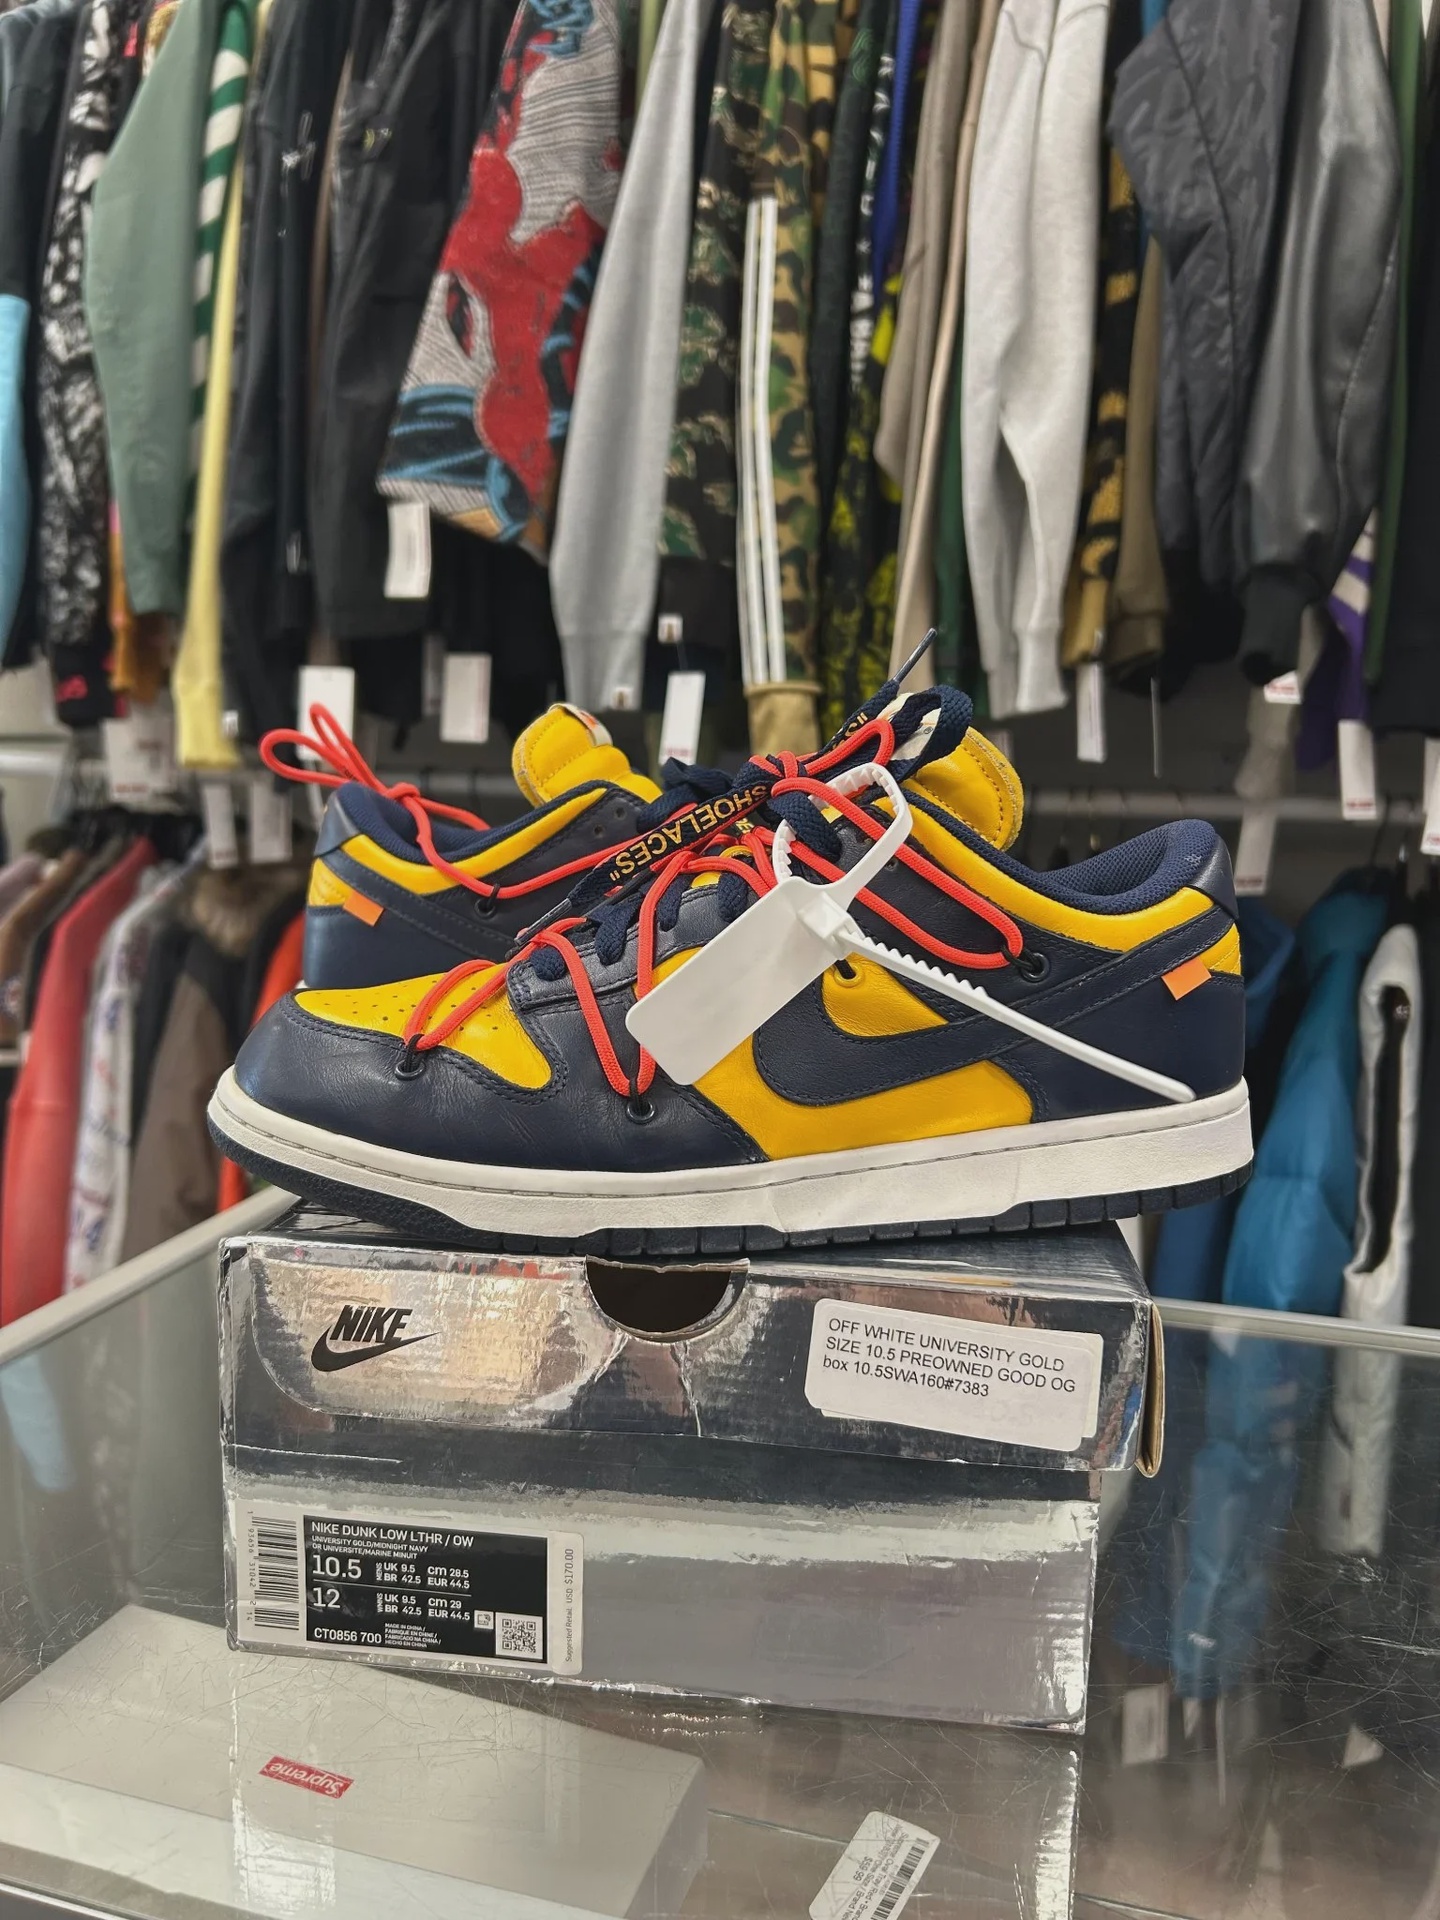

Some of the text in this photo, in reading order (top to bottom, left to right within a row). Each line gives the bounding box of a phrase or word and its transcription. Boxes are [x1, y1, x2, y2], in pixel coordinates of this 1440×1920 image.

[330, 1304, 413, 1343] NIKE
[828, 1317, 1065, 1372] OFF WHITE UNIVERSITY GOLD
[823, 1354, 989, 1397] box 10.5SWA160#7383
[825, 1337, 1076, 1393] SIZE 10.5 PREOWNED GOOD OG
[311, 1521, 339, 1534] NIKE
[342, 1524, 377, 1538] DUNK
[380, 1528, 408, 1541] LOW
[410, 1531, 443, 1545] LTHR
[453, 1535, 474, 1547] OW
[312, 1535, 428, 1553] UNIVERSITY GOLD/MIDNIGHT NAVY
[312, 1554, 362, 1579] 10.5
[393, 1551, 417, 1560] MINUIT
[564, 1548, 574, 1585] $170.00
[384, 1562, 469, 1578] UK 9.5 cm 28.5
[384, 1573, 470, 1589] BR 42.5 EUR 44.5
[312, 1587, 341, 1609] 12
[384, 1593, 462, 1609] UK 9.5 cm 29
[565, 1588, 573, 1603] USD
[384, 1604, 470, 1621] BR 42.5 EUR 44.5
[314, 1627, 382, 1644] CT0856 700
[564, 1628, 574, 1663] Suggested
[269, 1762, 344, 1796] Supreme
